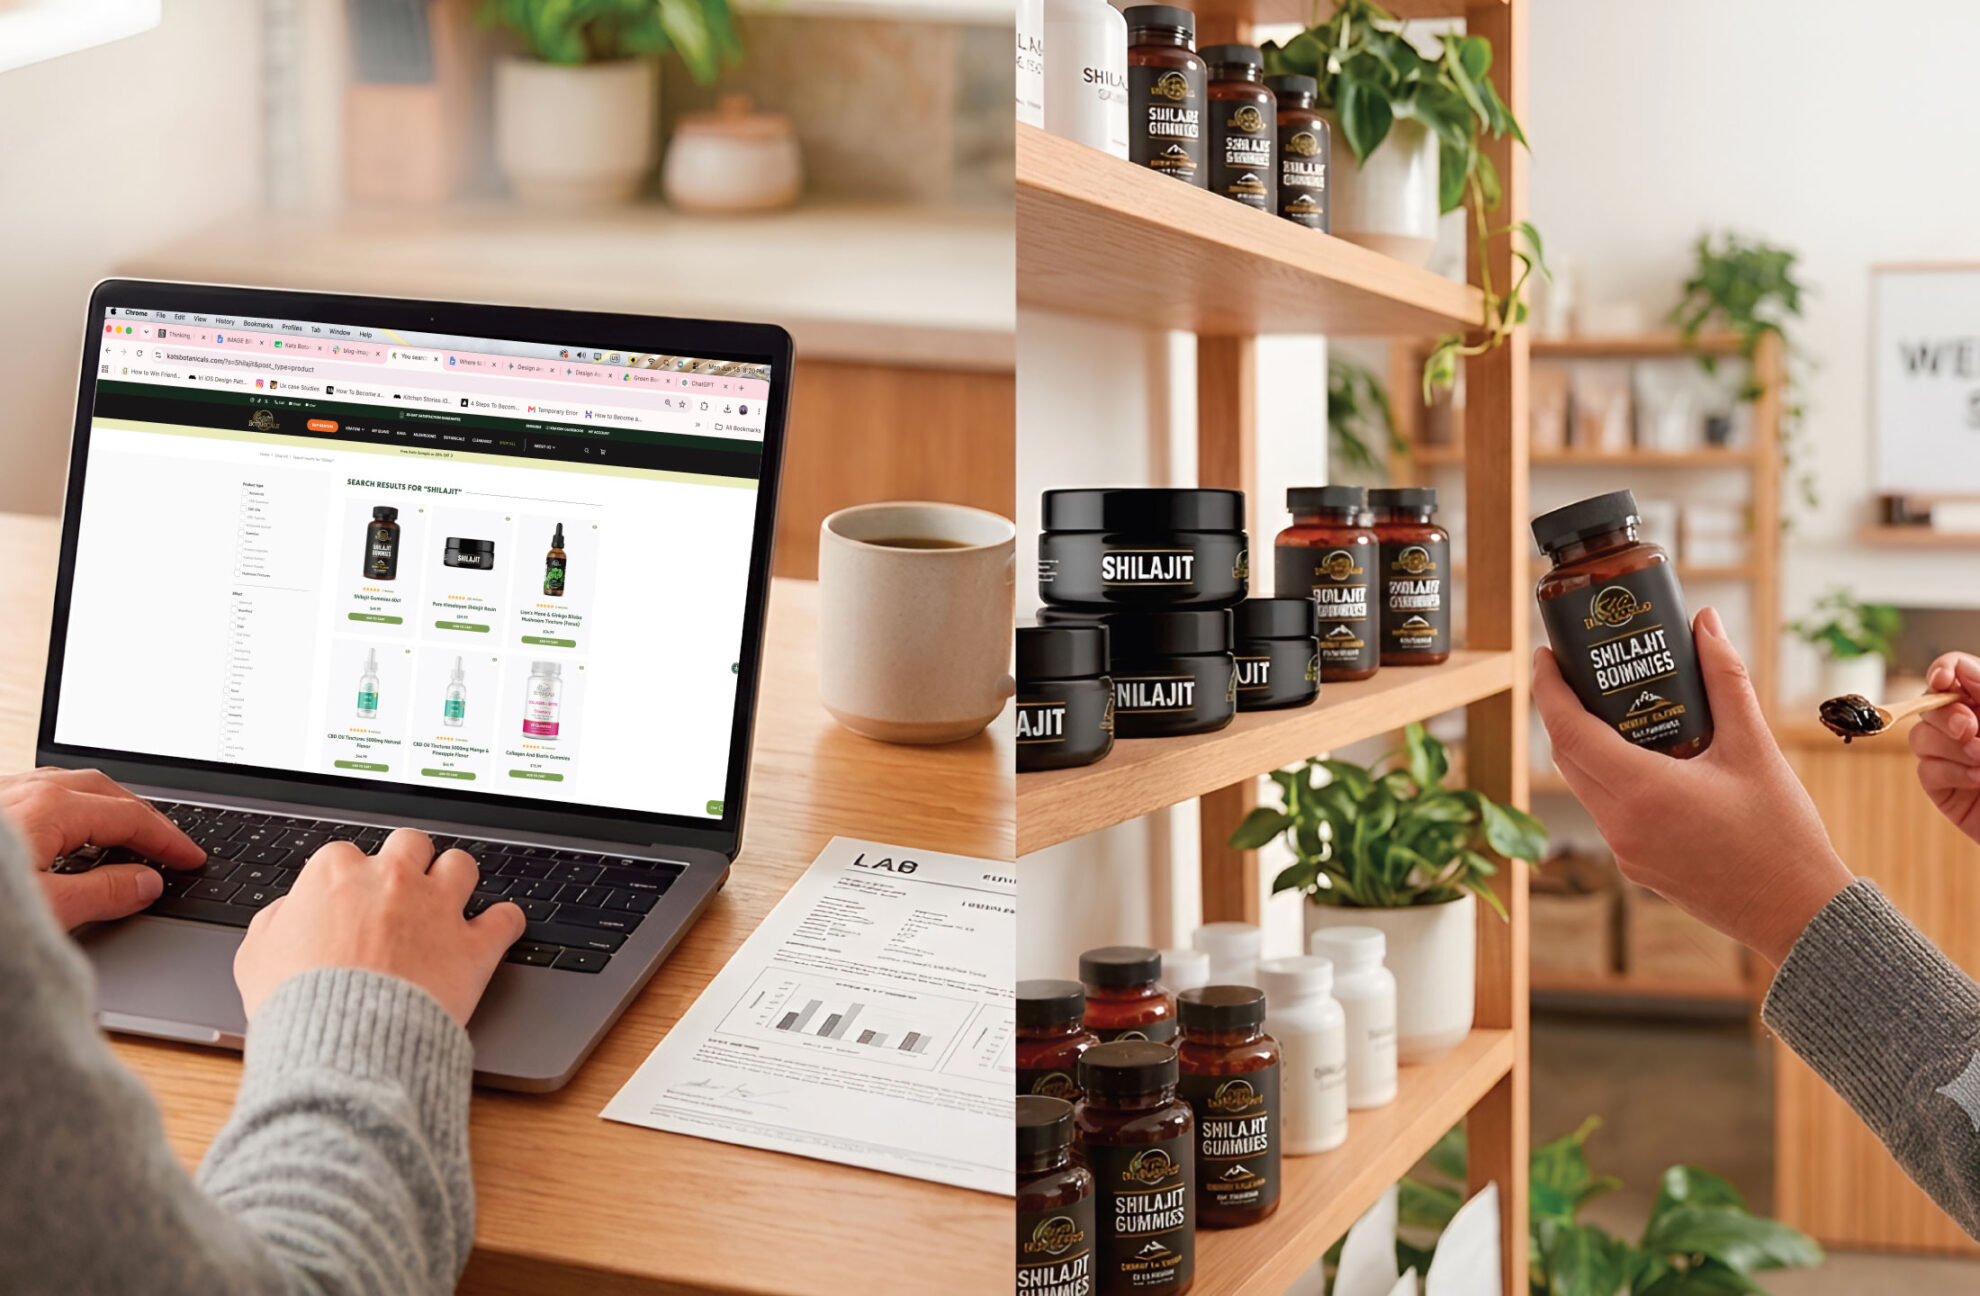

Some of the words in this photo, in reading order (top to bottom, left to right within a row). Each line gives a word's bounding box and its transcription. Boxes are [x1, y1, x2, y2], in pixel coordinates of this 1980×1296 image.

[126, 308, 148, 317] Chrome
[194, 315, 207, 323] View
[216, 317, 236, 326] History
[244, 320, 274, 330] Bookmarks
[282, 324, 303, 333] Profiles
[312, 326, 321, 334] Tab
[330, 328, 351, 337] Window
[360, 330, 373, 339] Help
[170, 332, 191, 340] Thinking
[228, 336, 245, 344] IMAGE
[460, 358, 475, 366] Where
[518, 364, 534, 373] Design
[576, 370, 593, 379] Design
[215, 376, 233, 384] Design
[692, 380, 714, 388] ChatGPT
[301, 384, 320, 392] Studies
[476, 402, 490, 410] Steps
[539, 407, 565, 416] Temporary
[613, 414, 633, 422] Become
[733, 425, 761, 434] Bookmarks
[347, 478, 376, 488] SEARCH
[376, 481, 406, 491] RESULTS
[408, 484, 422, 492] FOR
[1102, 556, 1194, 580] SHILAJIT
[506, 750, 526, 758] Collagen
[550, 754, 571, 762] Gummies
[853, 853, 918, 874] LAB
